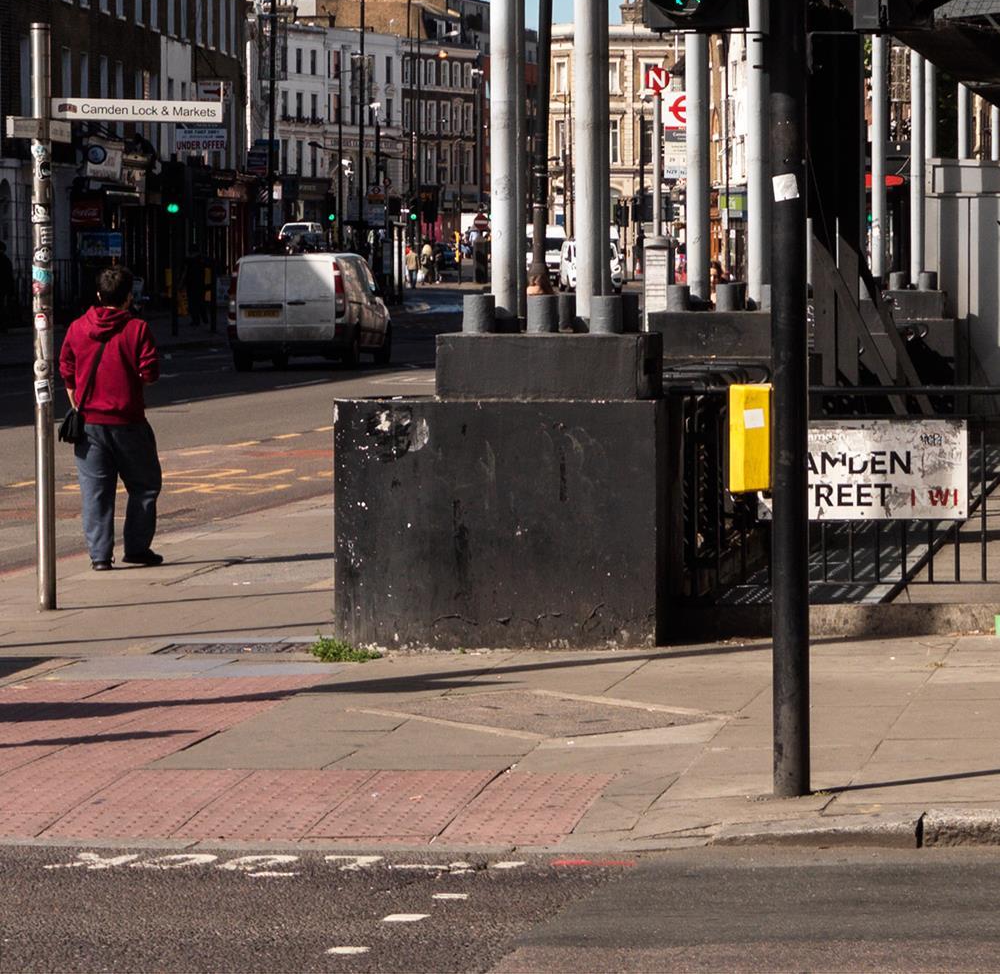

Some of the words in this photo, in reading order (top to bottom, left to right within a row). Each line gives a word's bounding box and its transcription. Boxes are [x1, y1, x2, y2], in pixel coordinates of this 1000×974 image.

[648, 70, 666, 89] N
[81, 103, 129, 115] Camden
[131, 105, 158, 116] Lock
[160, 106, 170, 116] &
[172, 106, 217, 117] Markets
[176, 140, 201, 150] UNDER
[202, 140, 225, 150] OFFER
[808, 451, 911, 474] AMDEN
